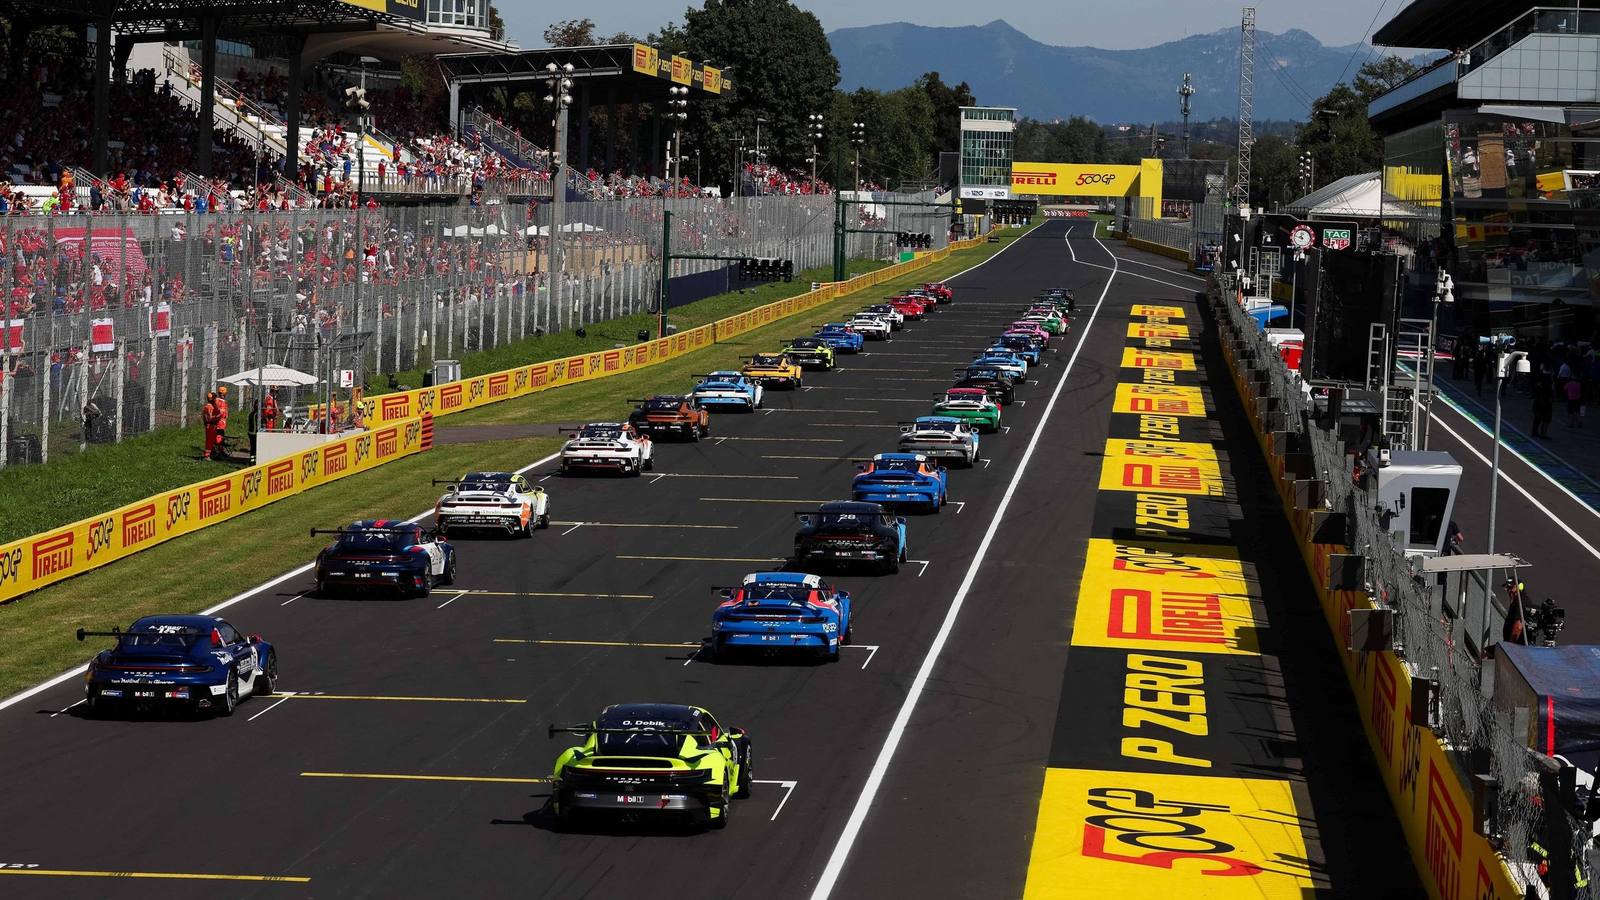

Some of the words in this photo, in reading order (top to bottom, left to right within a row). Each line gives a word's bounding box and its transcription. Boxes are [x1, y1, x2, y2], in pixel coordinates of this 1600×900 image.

[382, 394, 409, 421] PIRELLI
[417, 390, 435, 414] 500GP
[441, 384, 462, 410] PIRELLI
[469, 379, 484, 402] 500GP
[489, 374, 508, 398] PIRELLI
[531, 366, 548, 388] PIRELLI
[568, 358, 584, 379] PIRELLI
[604, 352, 619, 372] PIRELLI
[1140, 415, 1179, 434] ZERO
[1122, 463, 1202, 491] PIRELLI
[32, 531, 74, 580] PIRELLI
[86, 517, 114, 561] 500GP
[122, 503, 156, 548] PIRELLI
[166, 491, 190, 530] 500GP
[198, 479, 231, 520] PIRELLI
[240, 470, 261, 506] 500GP
[267, 459, 293, 496] PIRELLI
[301, 451, 318, 484] 500GP
[324, 443, 347, 476] PIRELLI
[354, 435, 370, 466] 500GP
[376, 428, 397, 458] PIRELLI
[404, 421, 420, 449] 500GP
[1136, 494, 1190, 529] ZERO
[1107, 588, 1226, 644] PIRELLI
[1122, 653, 1208, 736] ZERO
[1121, 737, 1212, 767] P
[617, 795, 636, 804] Mobil
[1082, 787, 1263, 877] 500GP
